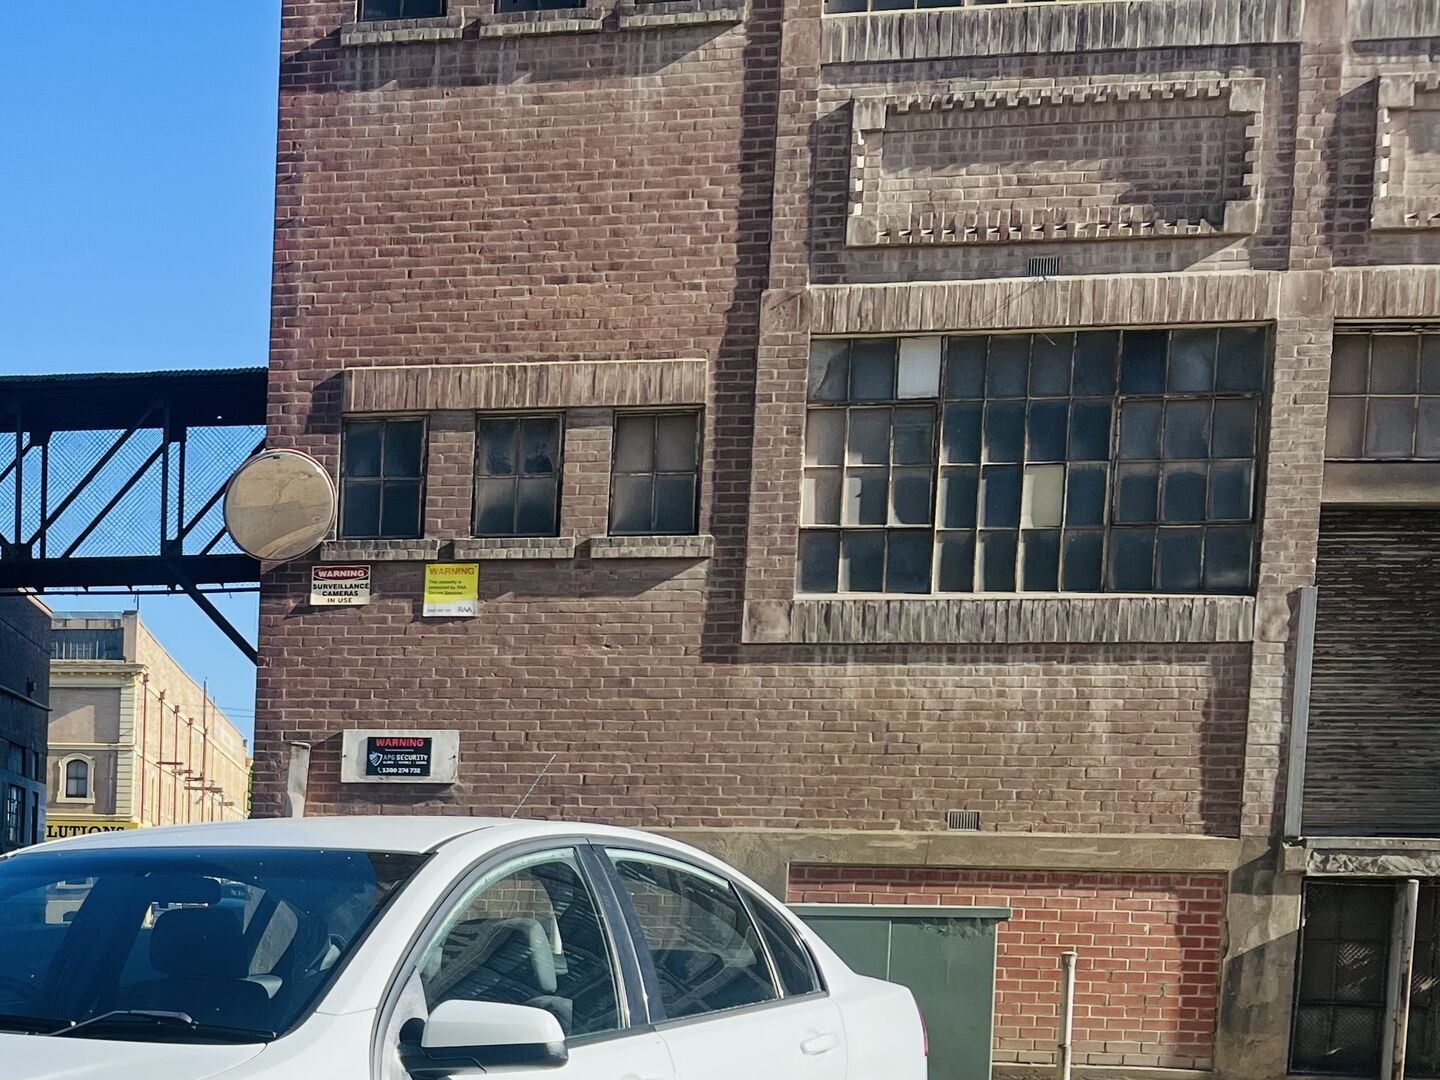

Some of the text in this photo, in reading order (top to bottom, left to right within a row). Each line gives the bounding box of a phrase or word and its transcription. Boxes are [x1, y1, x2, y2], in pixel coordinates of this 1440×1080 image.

[318, 570, 365, 578] WARNING
[429, 567, 475, 575] WARNING
[376, 738, 424, 746] WARNING
[46, 825, 125, 838] LUTIO
